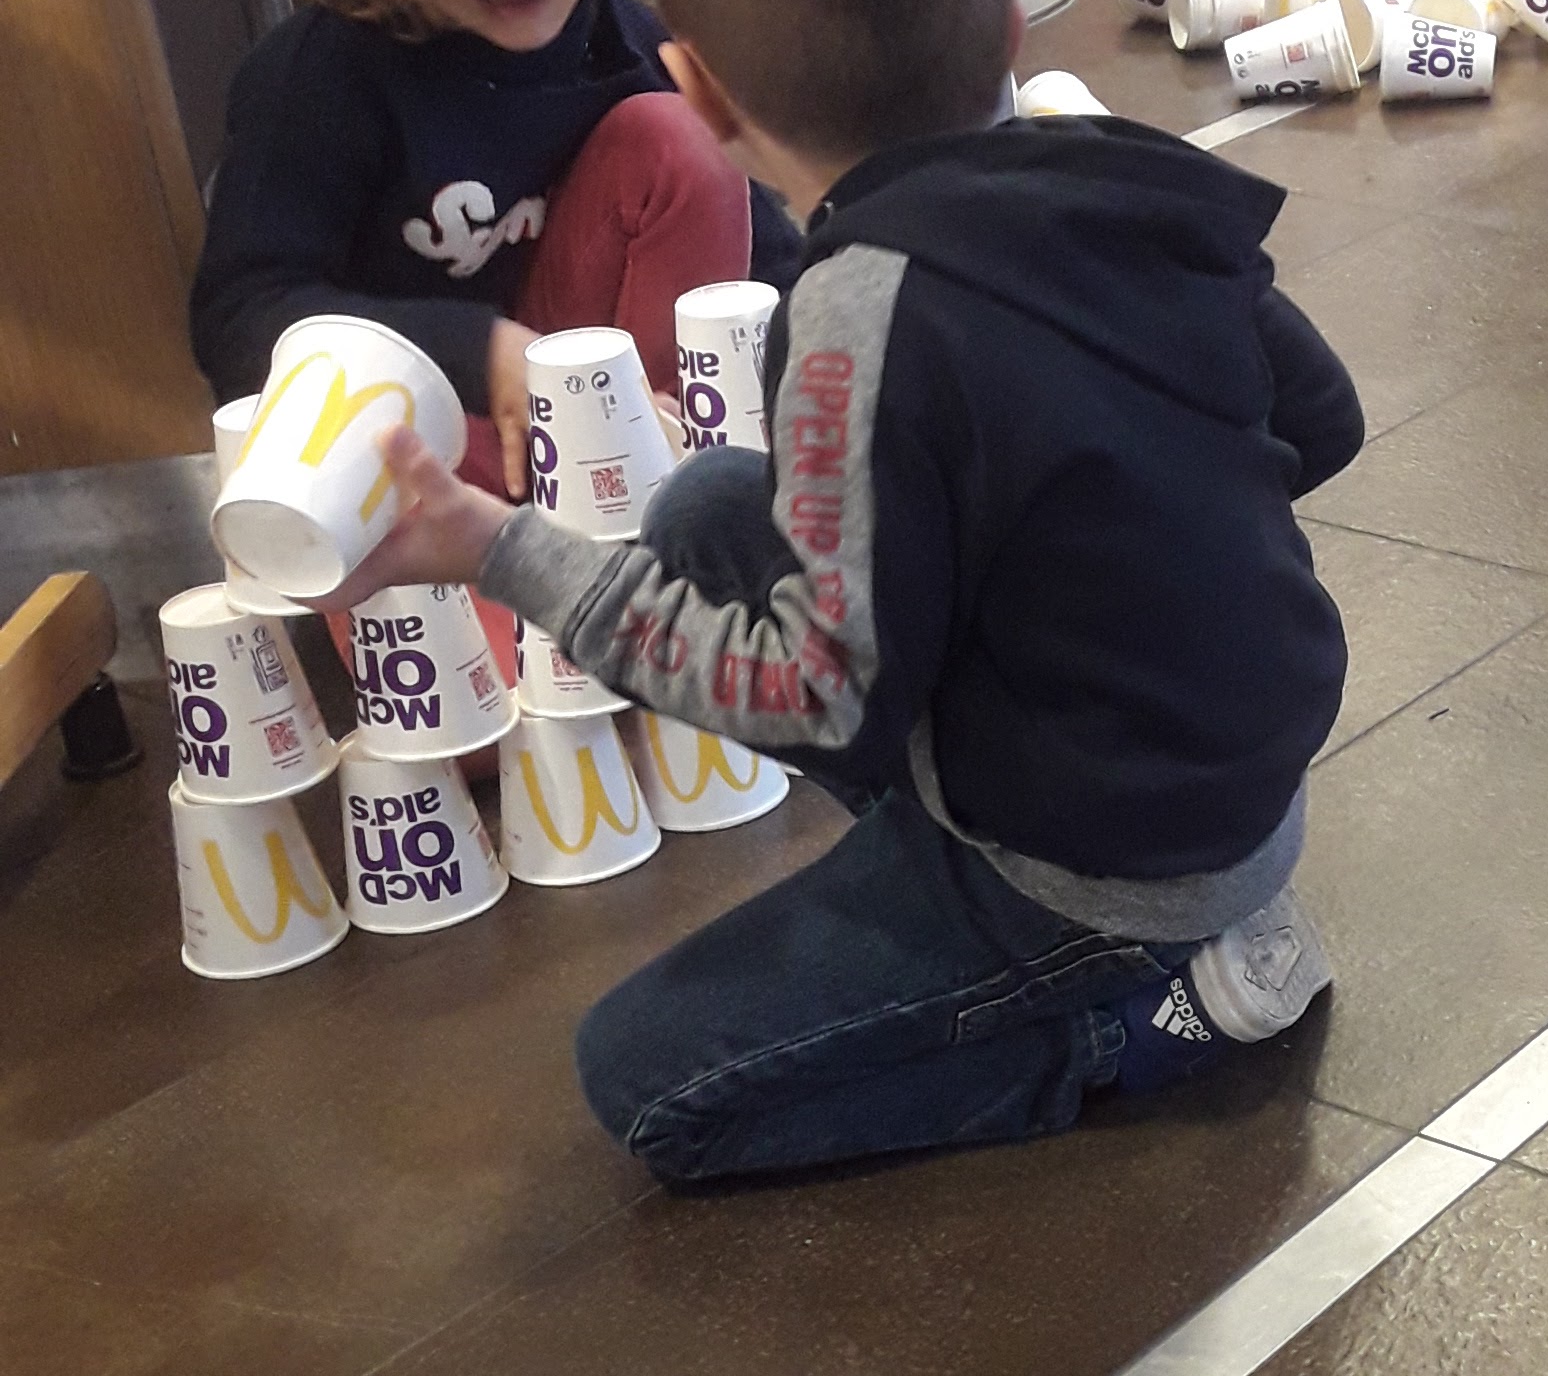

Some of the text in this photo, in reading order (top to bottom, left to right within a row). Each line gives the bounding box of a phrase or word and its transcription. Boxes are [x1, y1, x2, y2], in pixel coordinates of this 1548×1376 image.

[1406, 19, 1430, 75] McD
[793, 351, 853, 478] OPEN
[790, 495, 842, 556] UP
[350, 786, 442, 826] ald's
[359, 860, 463, 906] McD
[1170, 977, 1212, 1042] adidas
